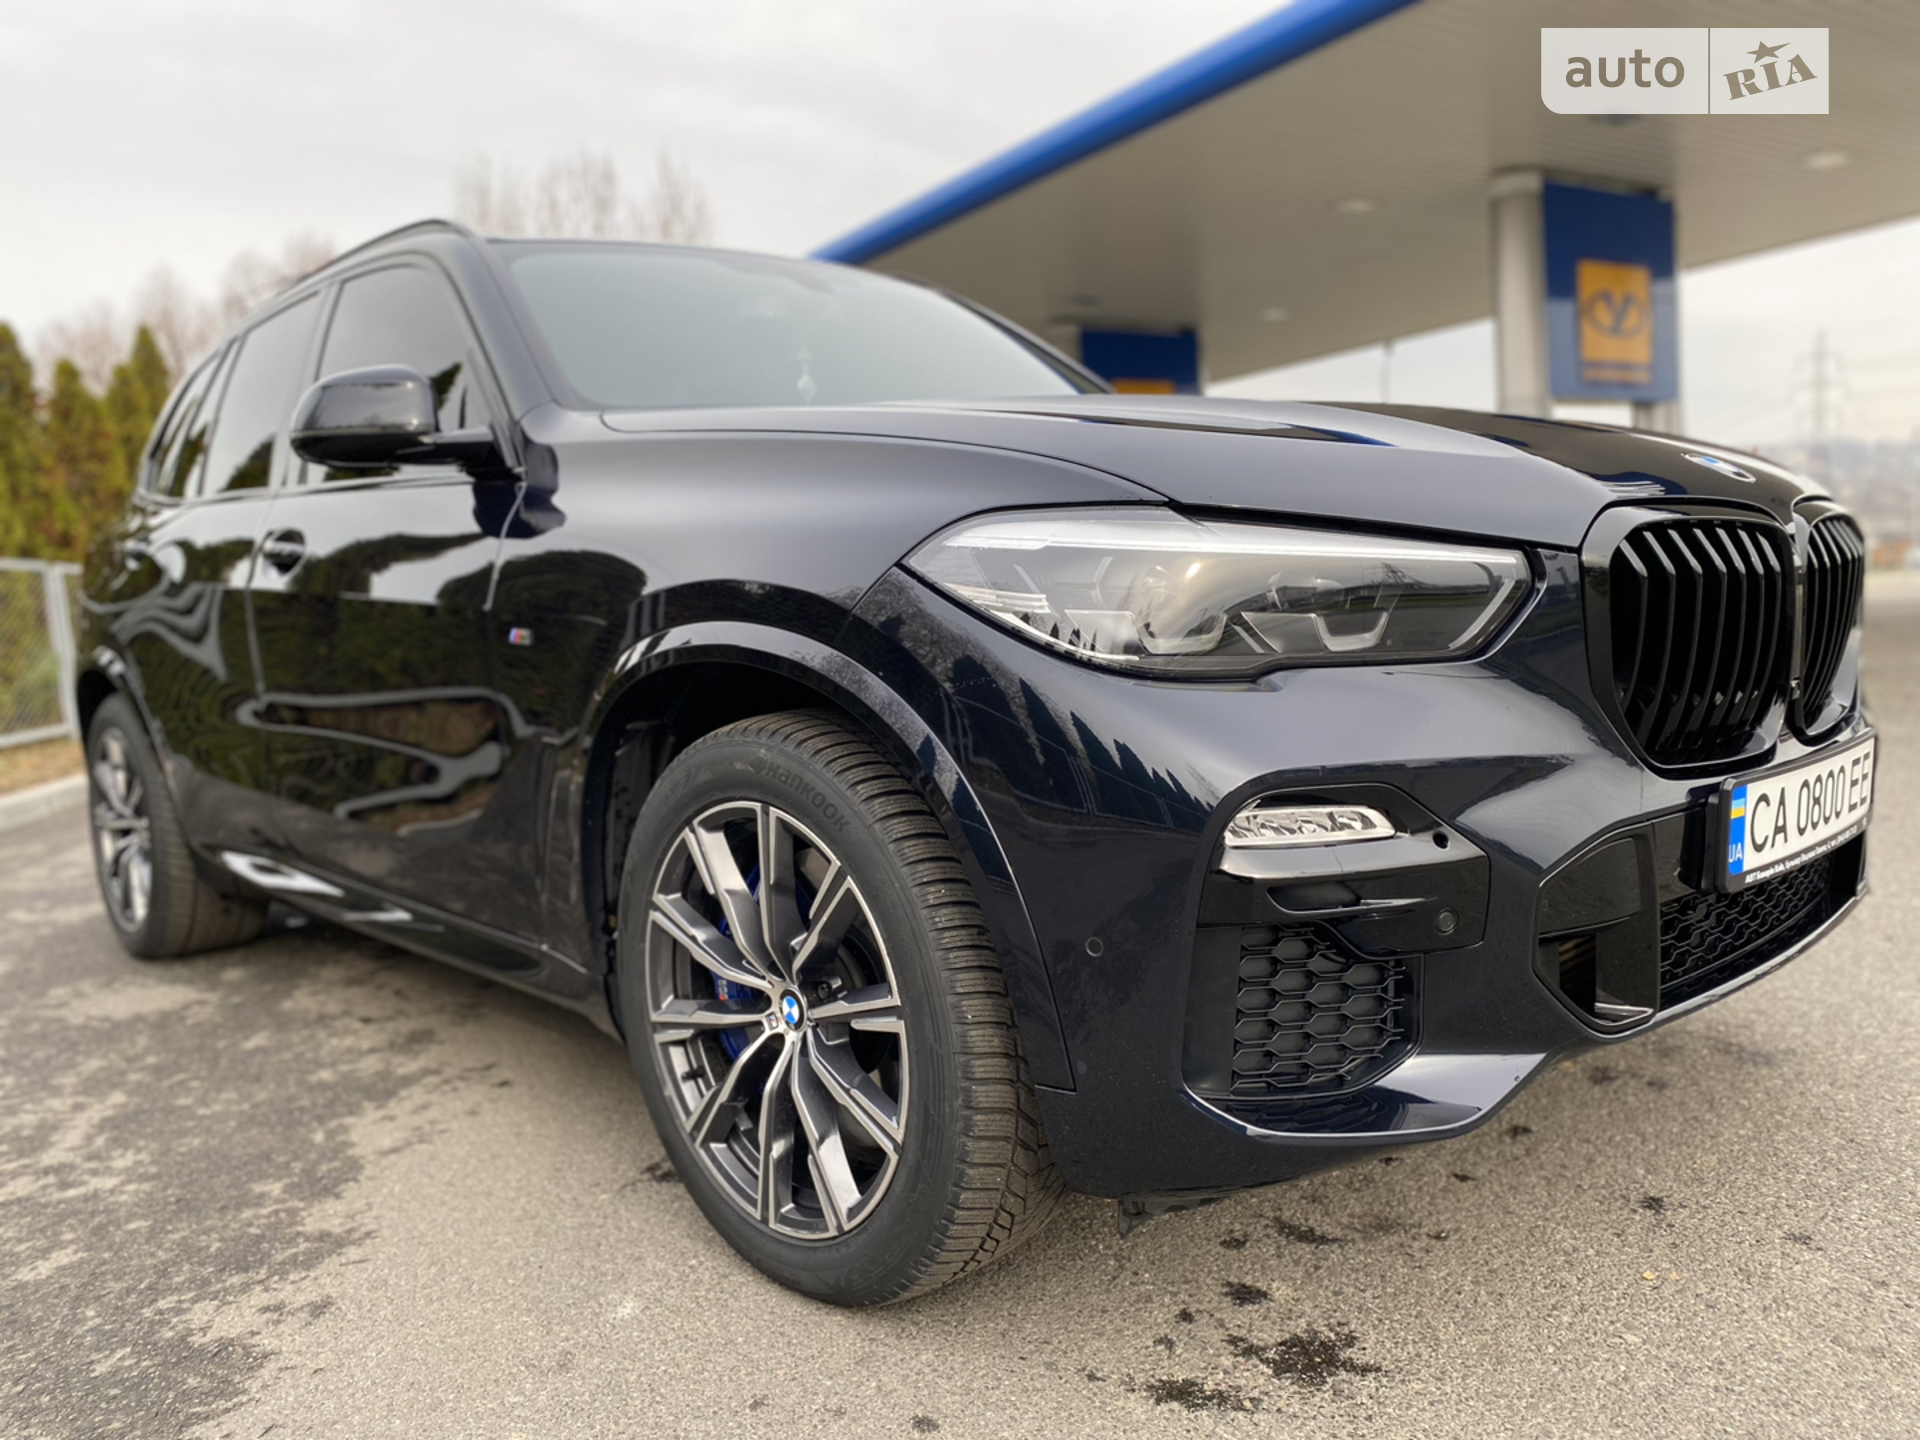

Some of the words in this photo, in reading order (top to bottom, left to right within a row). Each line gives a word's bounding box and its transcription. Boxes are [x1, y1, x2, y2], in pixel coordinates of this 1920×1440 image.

[1750, 786, 1788, 853] CA
[1797, 765, 1846, 836] 0800
[1848, 751, 1871, 814] EE
[1728, 842, 1743, 863] UA
